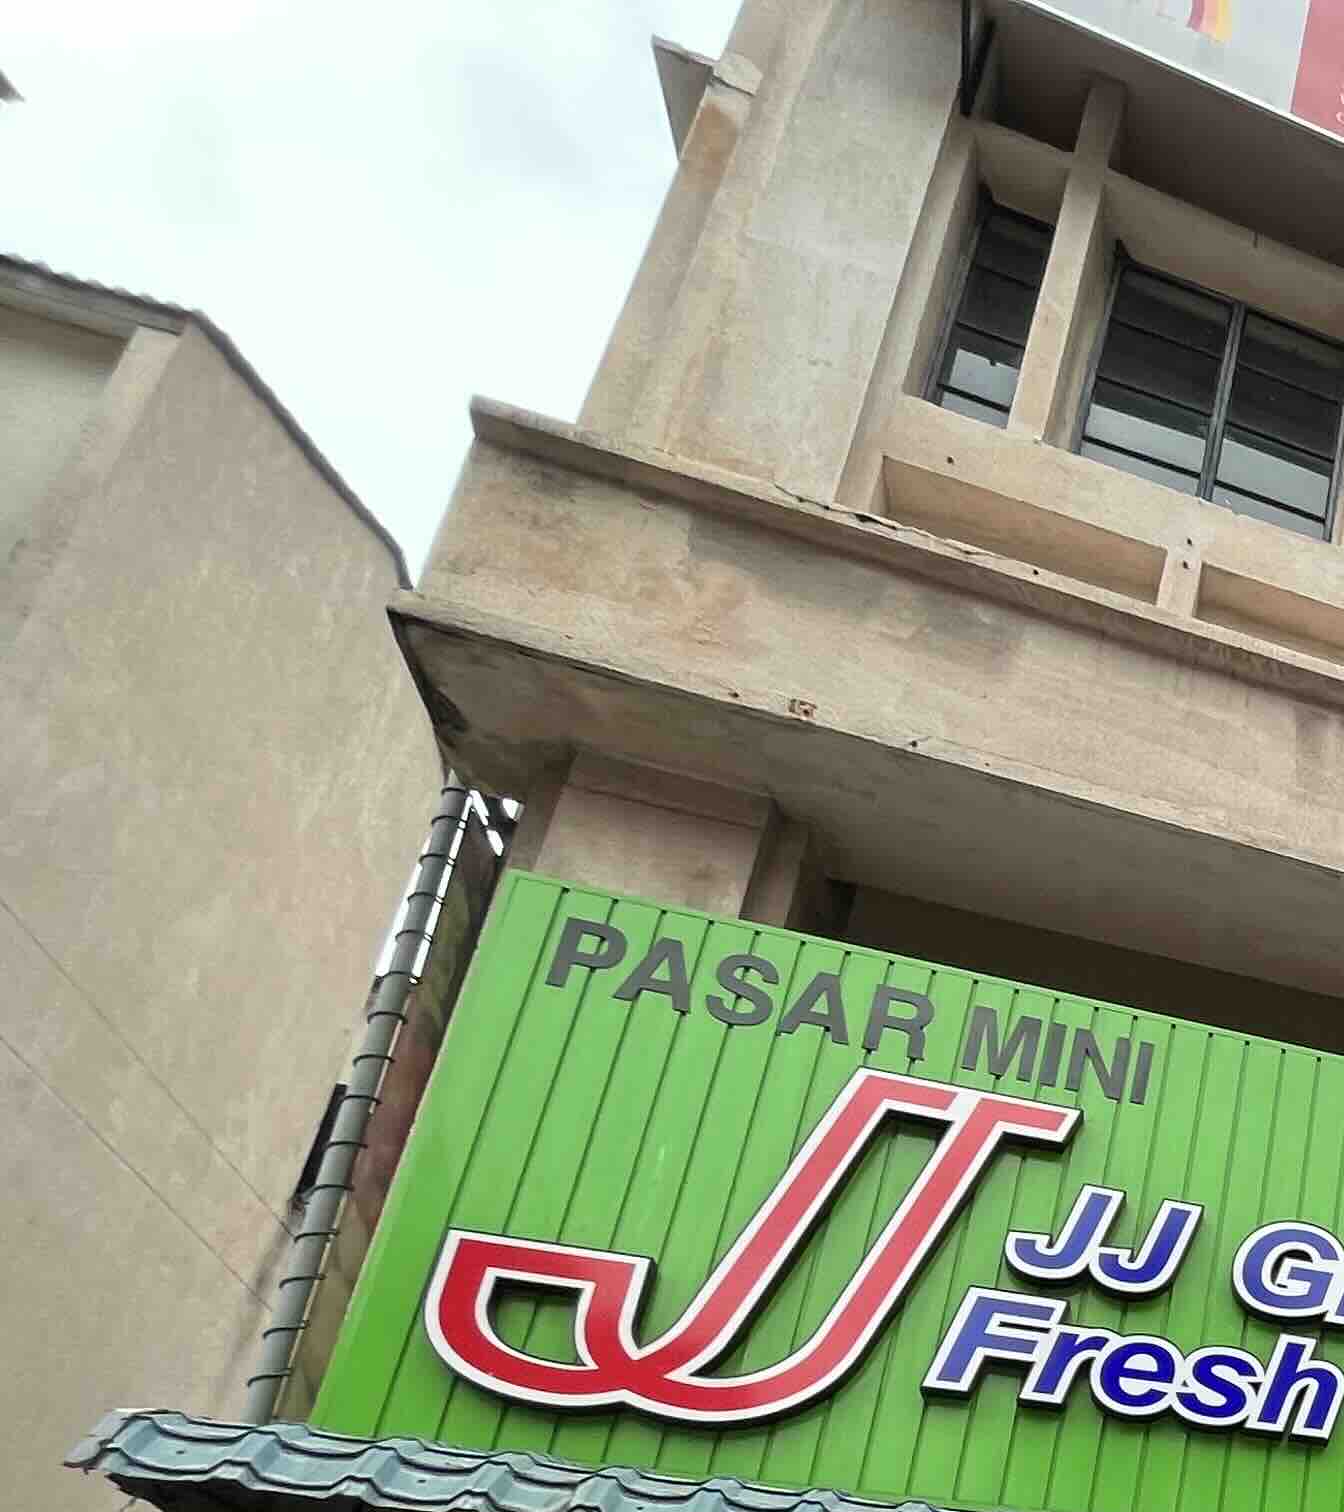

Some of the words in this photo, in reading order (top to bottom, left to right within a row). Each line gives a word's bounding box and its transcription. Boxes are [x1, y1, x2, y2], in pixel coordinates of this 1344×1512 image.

[544, 917, 936, 1063] PASAR
[961, 1006, 1156, 1105] MINI
[1005, 1184, 1203, 1297] JJ
